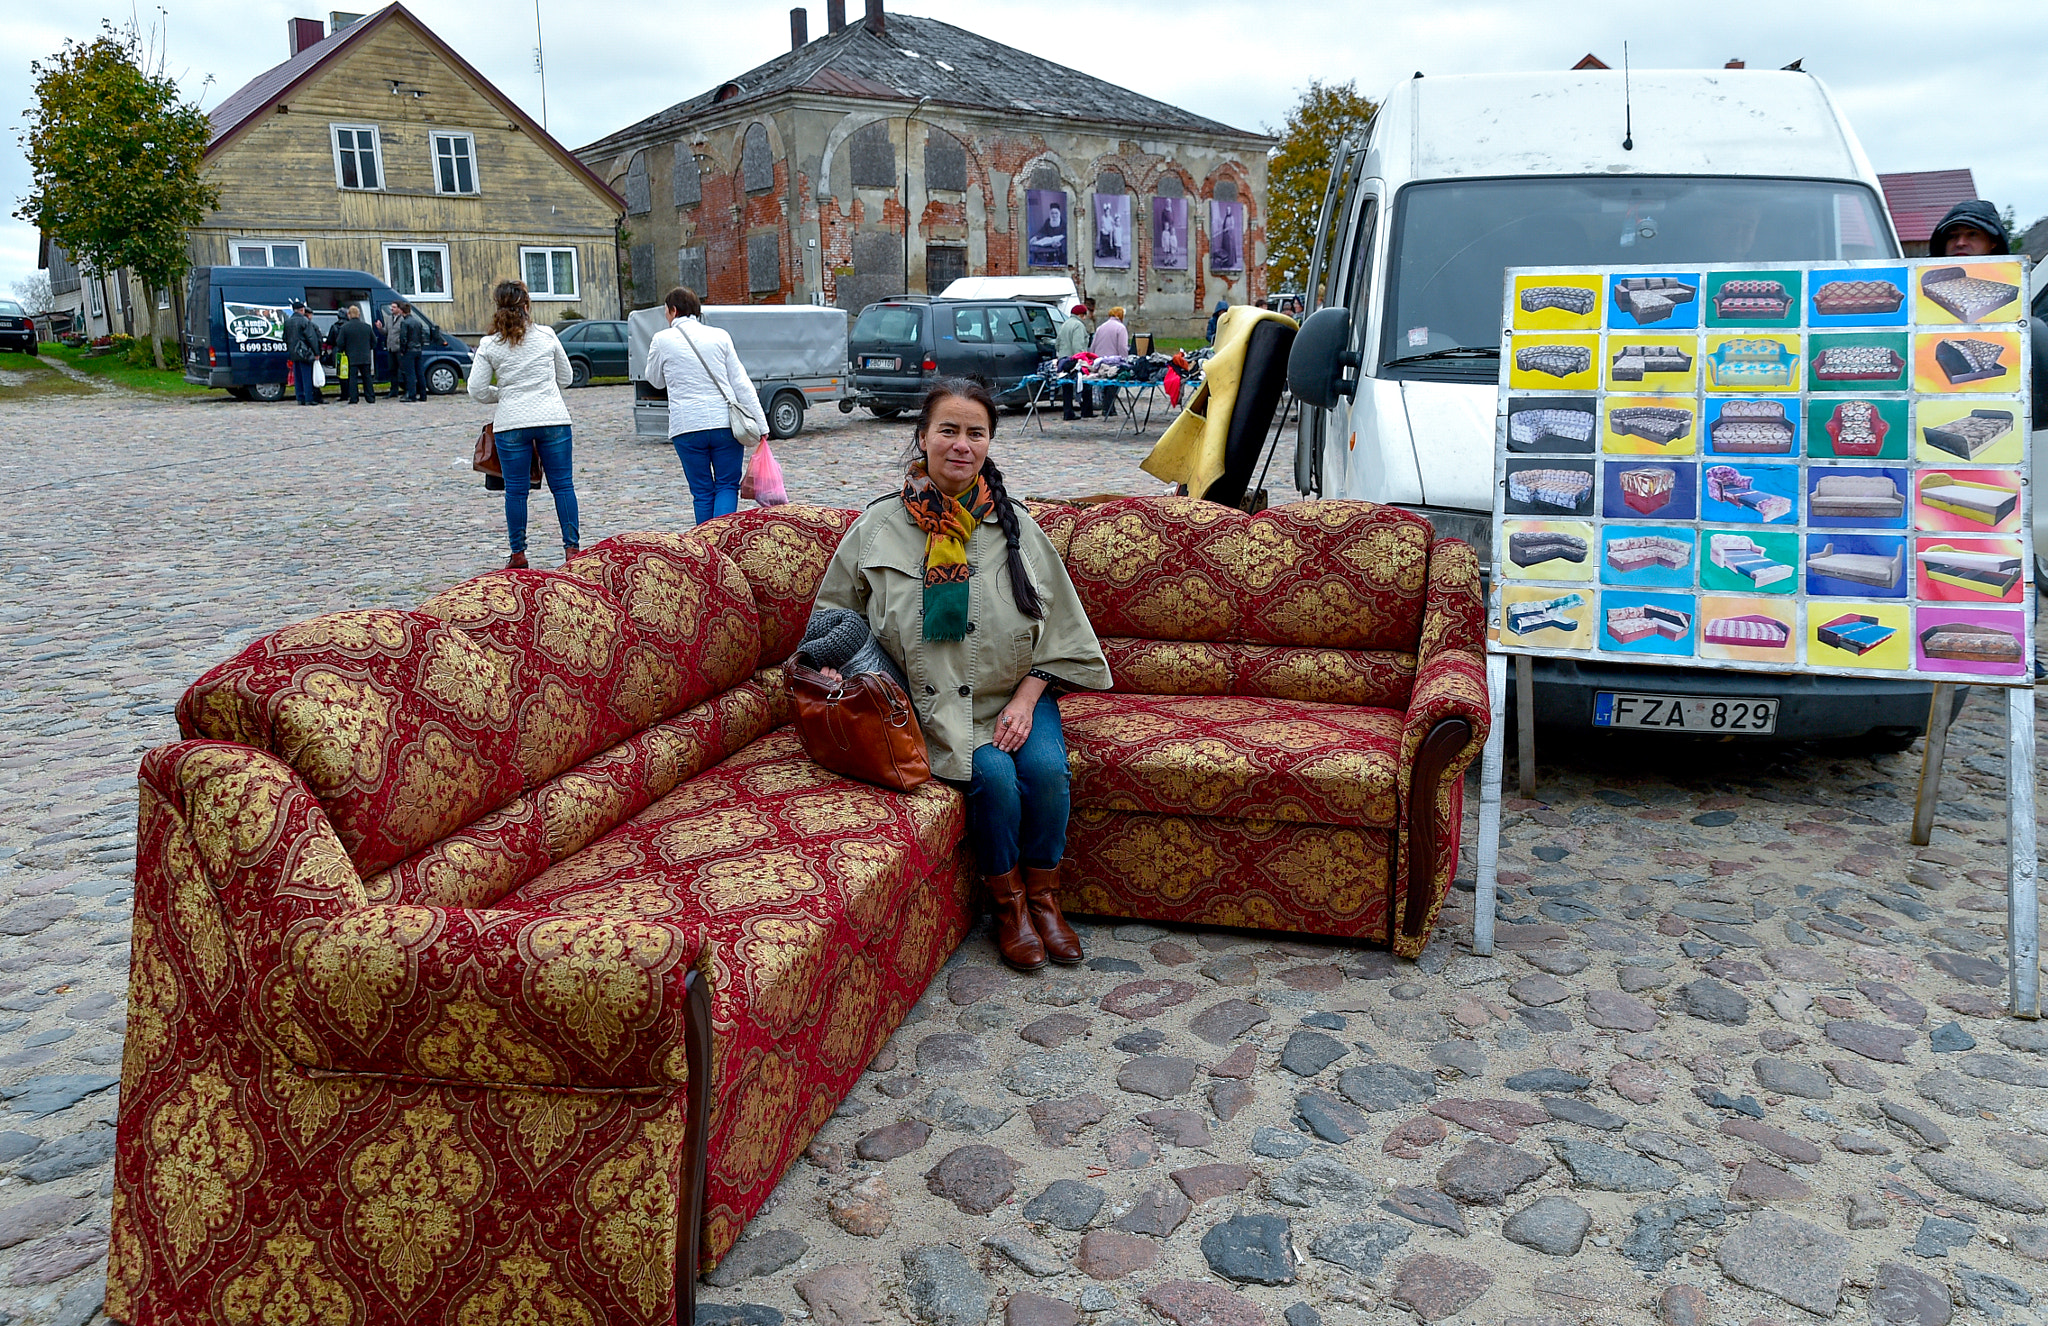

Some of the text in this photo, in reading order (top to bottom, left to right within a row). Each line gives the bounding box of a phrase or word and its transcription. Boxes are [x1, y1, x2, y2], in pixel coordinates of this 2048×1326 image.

[240, 343, 287, 352] 8 699 35 903
[1596, 713, 1610, 721] LT
[1615, 698, 1771, 729] FZA 829
